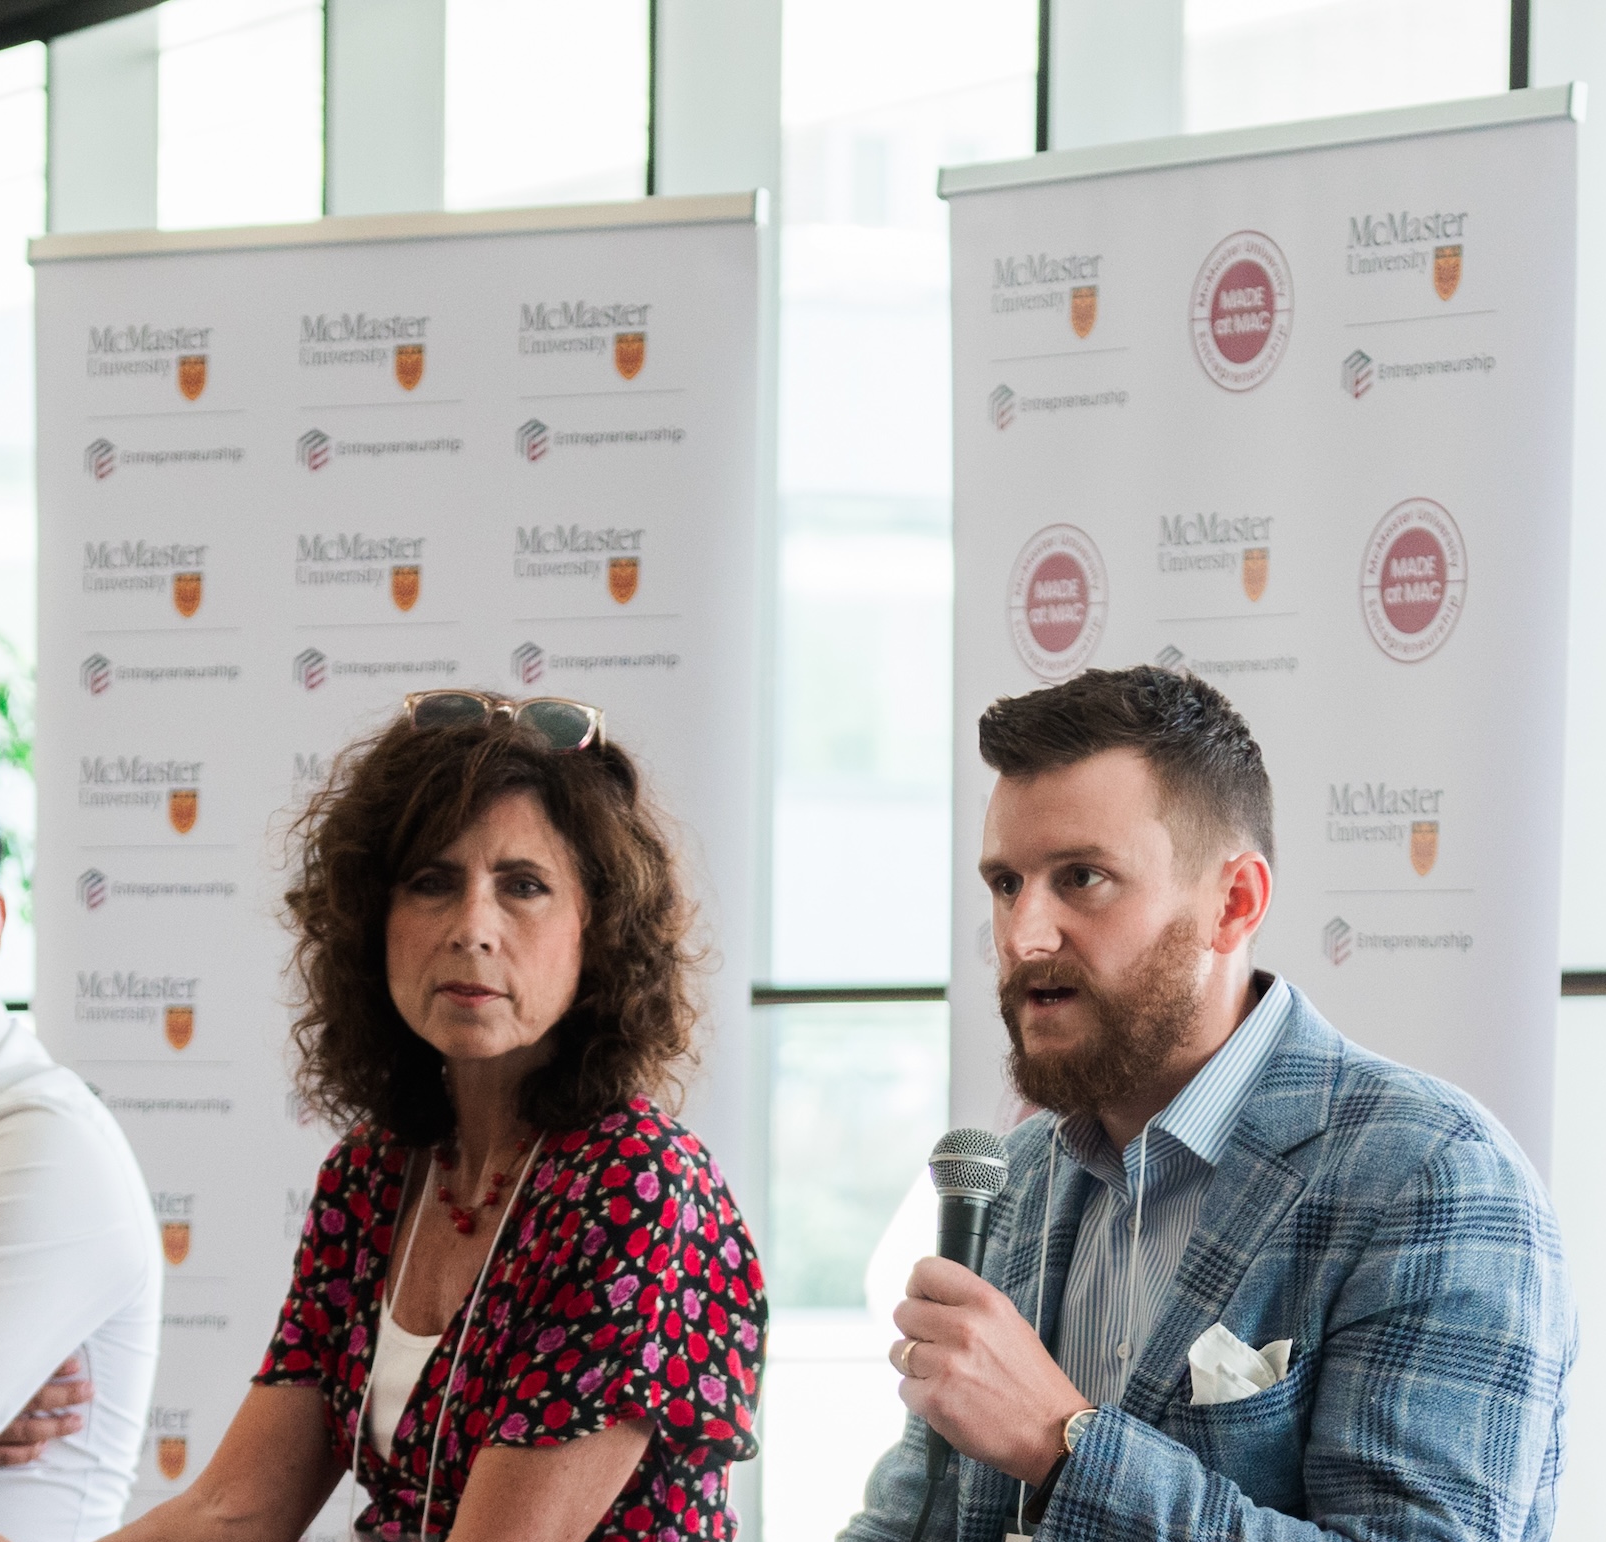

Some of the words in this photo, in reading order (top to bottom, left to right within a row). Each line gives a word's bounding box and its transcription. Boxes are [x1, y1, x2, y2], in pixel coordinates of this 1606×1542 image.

[1348, 209, 1468, 249] McMaster
[994, 252, 1103, 288] McMaster
[1347, 250, 1429, 276] University
[993, 289, 1065, 315] University
[1219, 286, 1266, 311] MADE
[300, 311, 431, 344] McMaster
[520, 301, 651, 332] McMaster
[1233, 310, 1271, 334] MAC
[88, 322, 214, 354] McMaster
[519, 333, 609, 357] University
[86, 355, 171, 381] University
[299, 346, 387, 370] University
[1379, 353, 1497, 381] Entrepreneurship
[1020, 389, 1129, 415] Entrepreneurship
[336, 435, 464, 457] Entrepreneurship
[555, 425, 686, 448] Entrepreneurship
[120, 444, 245, 466] Entrepreneurship
[515, 524, 644, 555] McMaster
[1158, 511, 1273, 547] McMaster
[84, 539, 208, 571] McMaster
[296, 532, 426, 563] McMaster
[514, 557, 602, 581] University
[1158, 550, 1239, 574] University
[1391, 555, 1436, 579] MADE
[82, 572, 168, 595] University
[295, 562, 384, 587] University
[1034, 577, 1080, 600] MADE
[1403, 580, 1443, 604] MAC
[1046, 602, 1085, 623] MAC
[117, 662, 240, 682] Entrepreneurship
[332, 655, 458, 677] Entrepreneurship
[550, 652, 679, 672] Entrepreneurship
[80, 755, 203, 786] McMaster
[79, 788, 163, 810] University
[1326, 782, 1444, 815] McMaster
[1327, 820, 1406, 846] University
[111, 878, 237, 899] Entrepreneurship
[1356, 931, 1474, 952] Entrepreneurship
[75, 971, 199, 1001] McMaster
[75, 1003, 158, 1025] University
